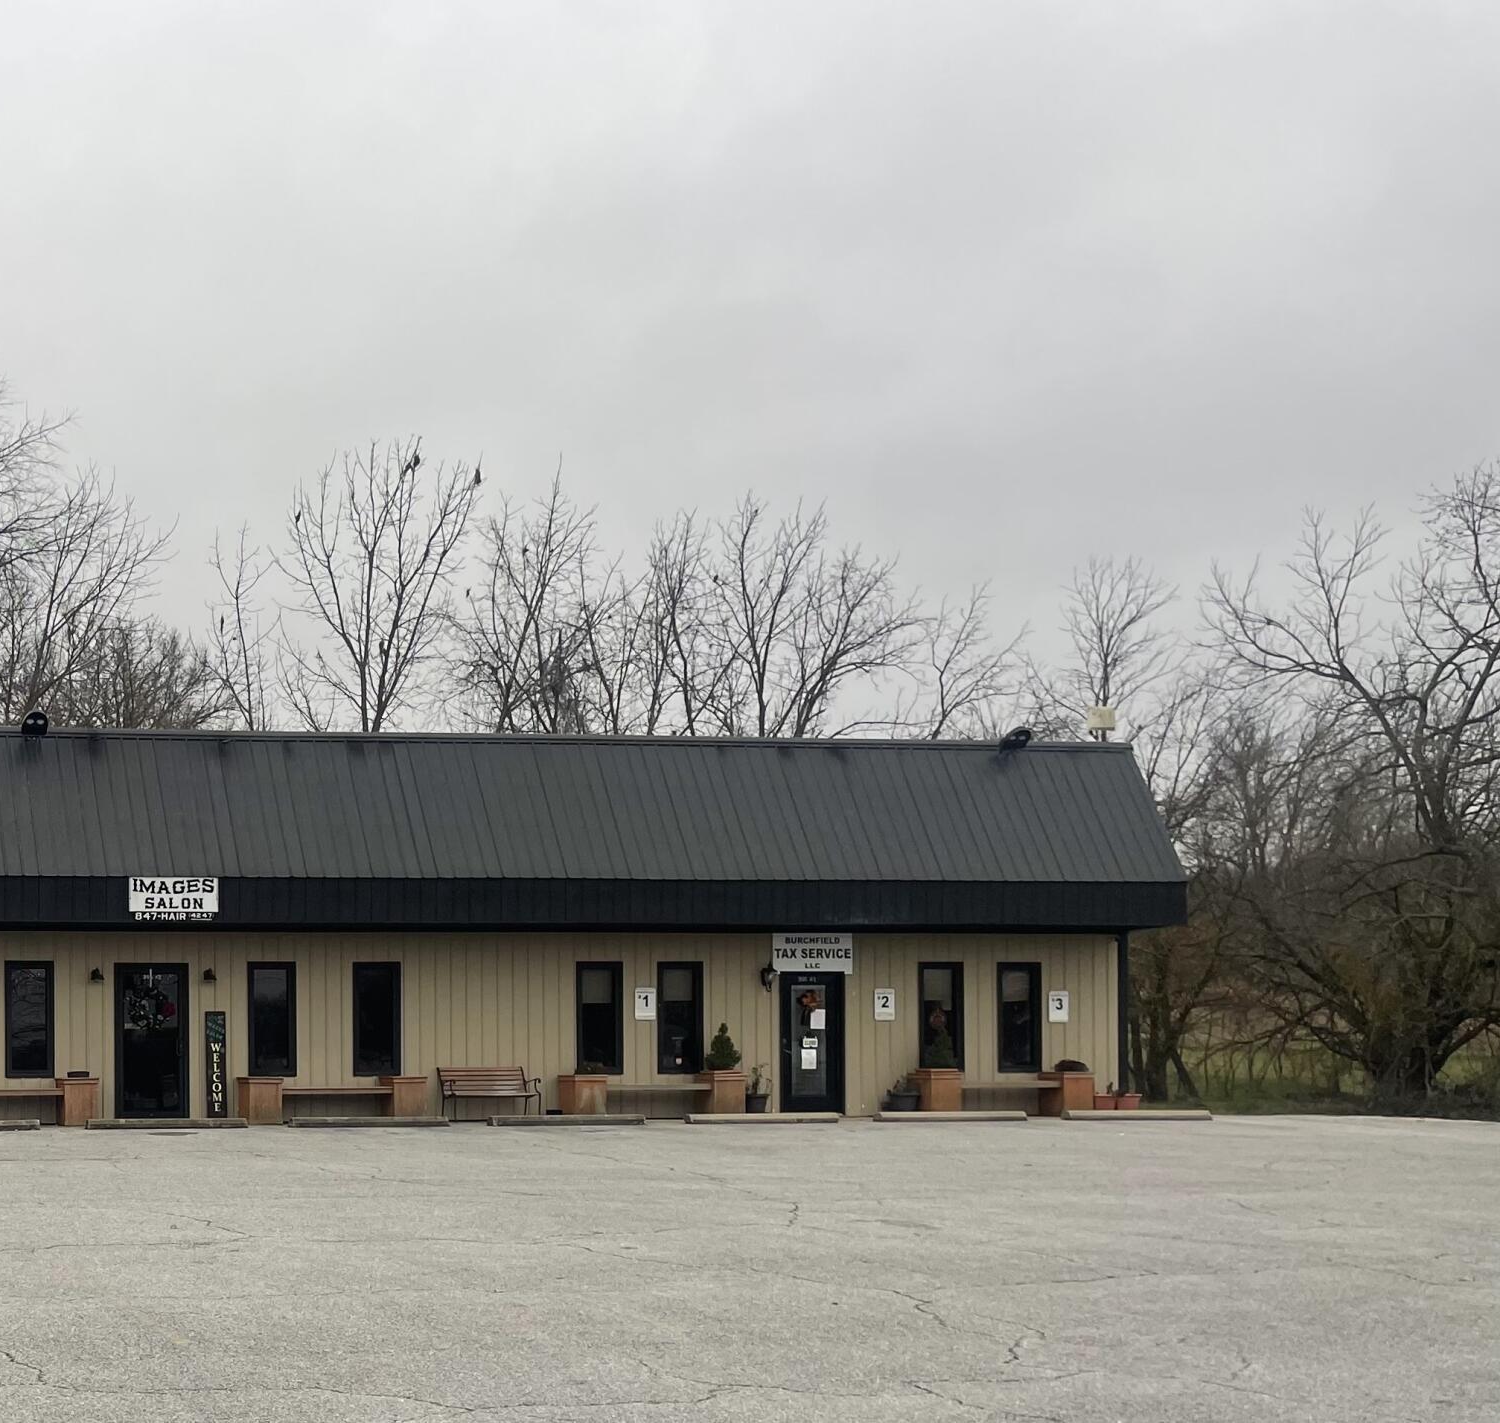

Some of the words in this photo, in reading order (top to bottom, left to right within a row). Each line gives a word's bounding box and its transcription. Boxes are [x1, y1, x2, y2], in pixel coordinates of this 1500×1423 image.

[132, 878, 214, 894] IMAGES
[145, 897, 203, 909] SALON
[785, 936, 840, 944] BURCHFIELD
[775, 948, 797, 959] TAX
[800, 948, 851, 959] SERVICE
[211, 1043, 222, 1112] WELCOME
